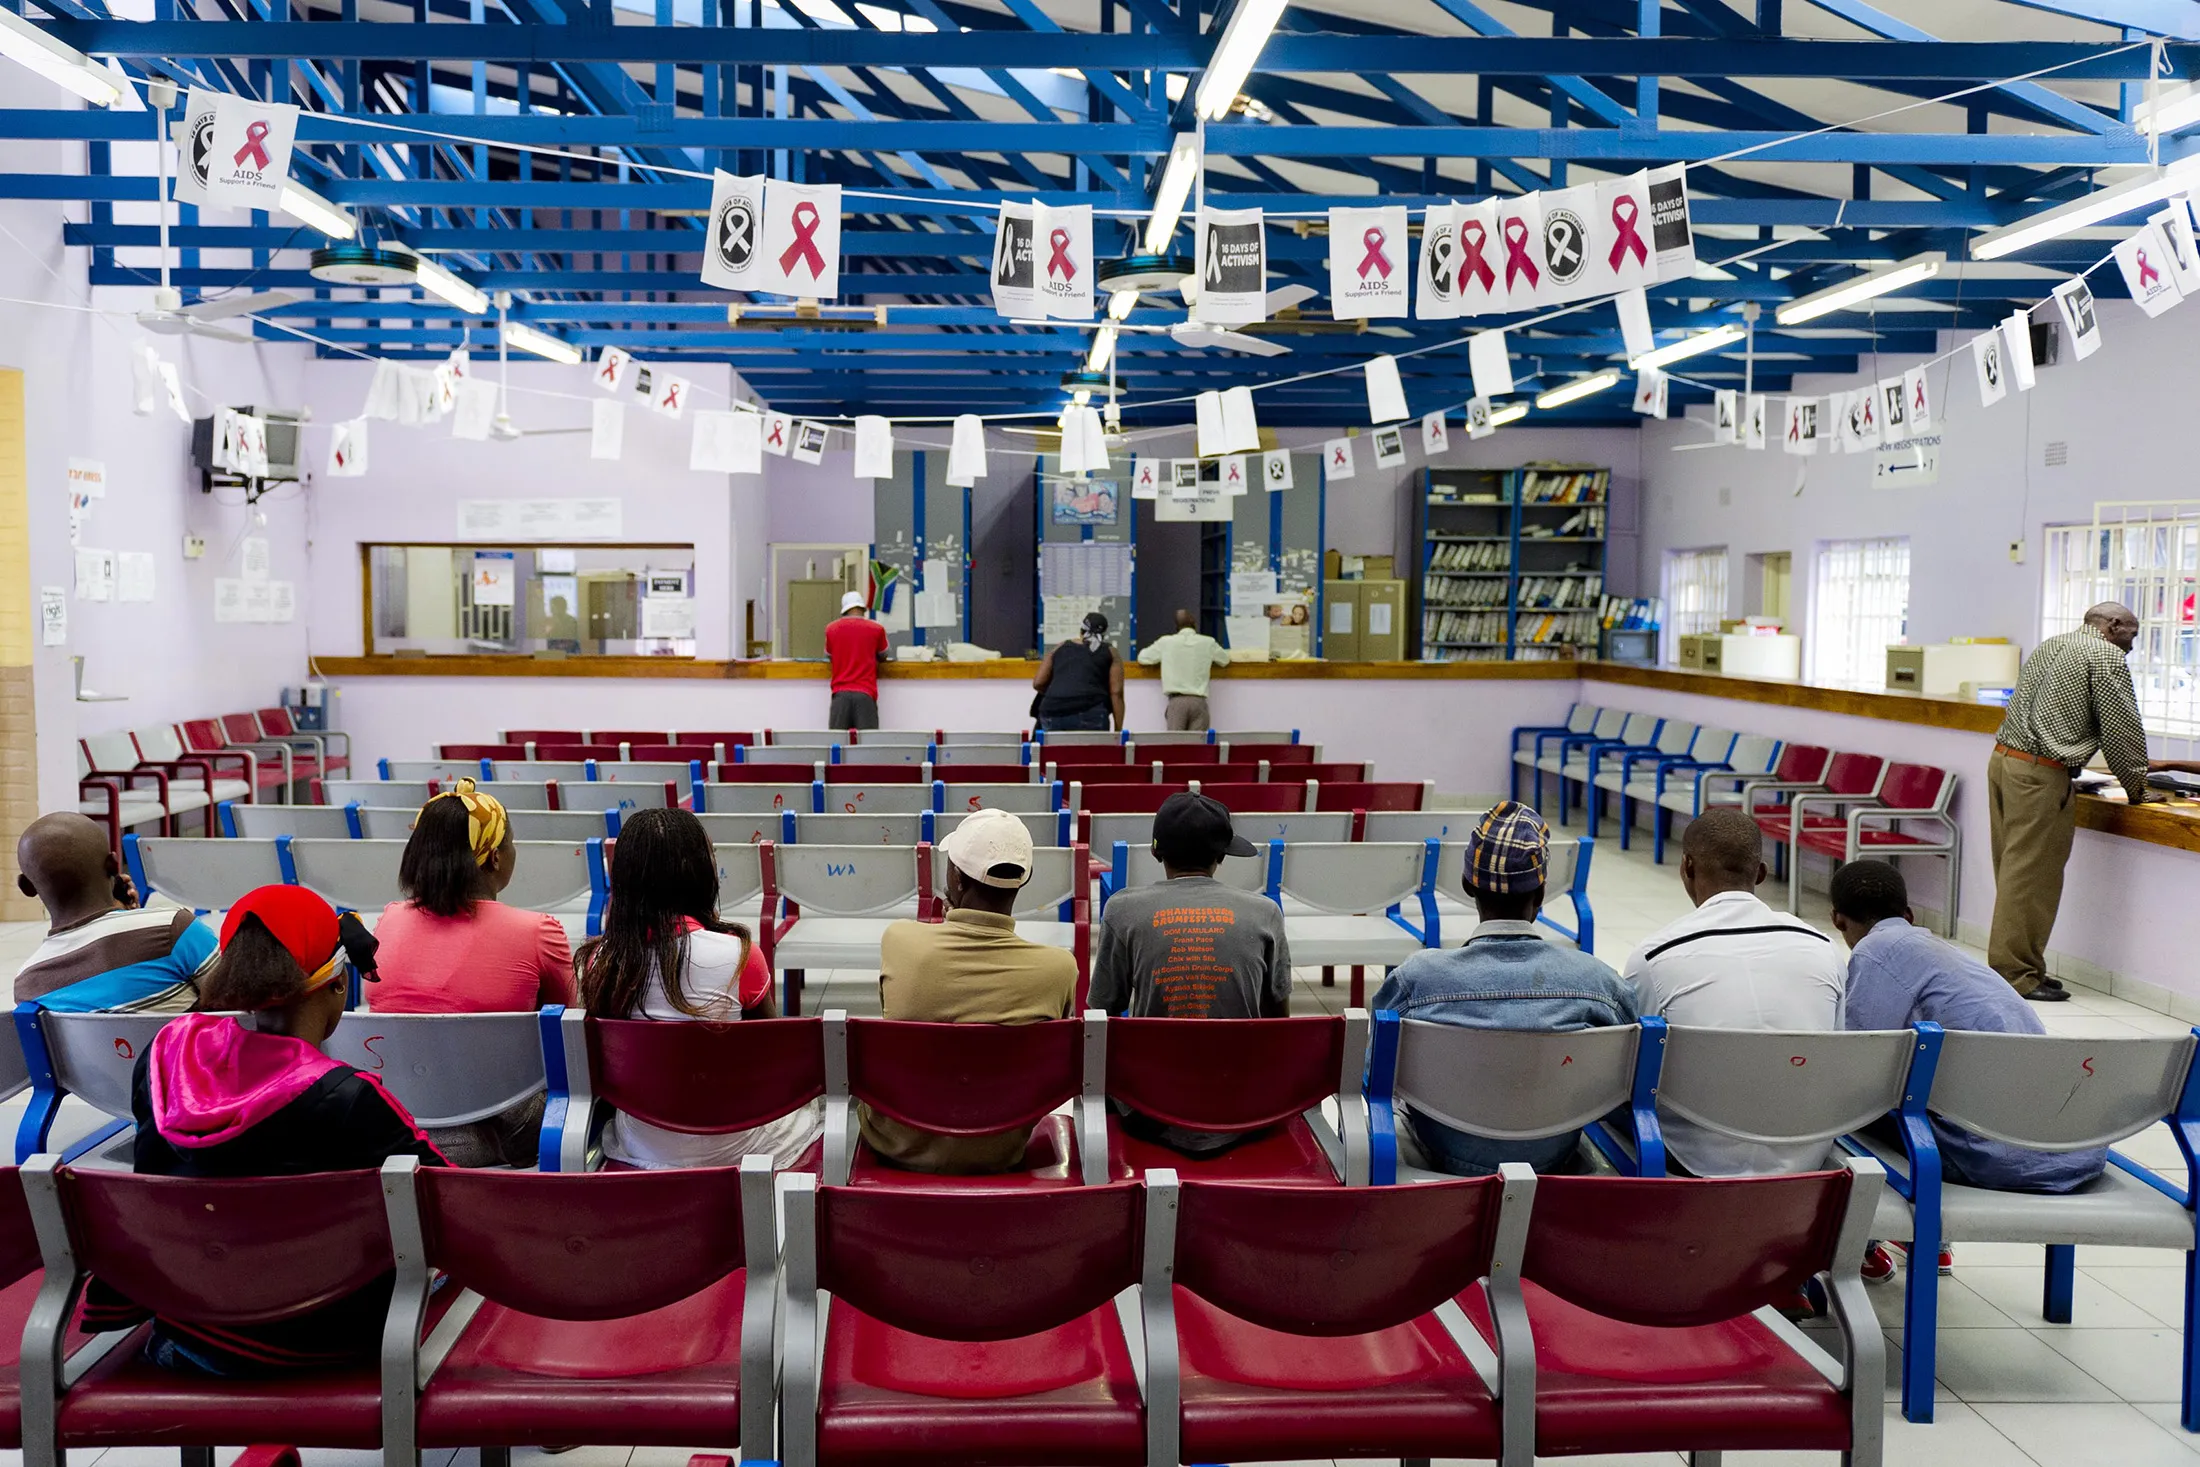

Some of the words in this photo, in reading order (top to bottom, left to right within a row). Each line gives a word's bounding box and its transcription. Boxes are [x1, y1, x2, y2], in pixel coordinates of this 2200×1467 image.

[232, 169, 263, 181] AIDS
[219, 177, 245, 186] Support
[252, 181, 277, 190] Friend
[1657, 199, 1676, 212] DAYS
[1675, 196, 1683, 207] OF
[1651, 207, 1686, 226] ACTIVISM
[1560, 211, 1585, 236] ACTIVISM
[1016, 237, 1024, 248] 16
[1221, 243, 1229, 254] 16
[1229, 243, 1249, 254] DAYS
[1249, 242, 1259, 253] OF
[1015, 248, 1034, 262] ACTI
[1221, 253, 1259, 267] ACTIVISM
[1048, 280, 1073, 292] AIDS
[1359, 281, 1389, 291] AIDS
[1878, 463, 1884, 476] 2
[1189, 504, 1196, 513] 3
[1154, 908, 1234, 918] JOHANNESBURG
[1153, 915, 1207, 927] DRUMFEST
[1191, 964, 1212, 972] Drum
[1212, 965, 1234, 973] Corps
[364, 1035, 386, 1070] S
[2081, 1057, 2094, 1078] S
